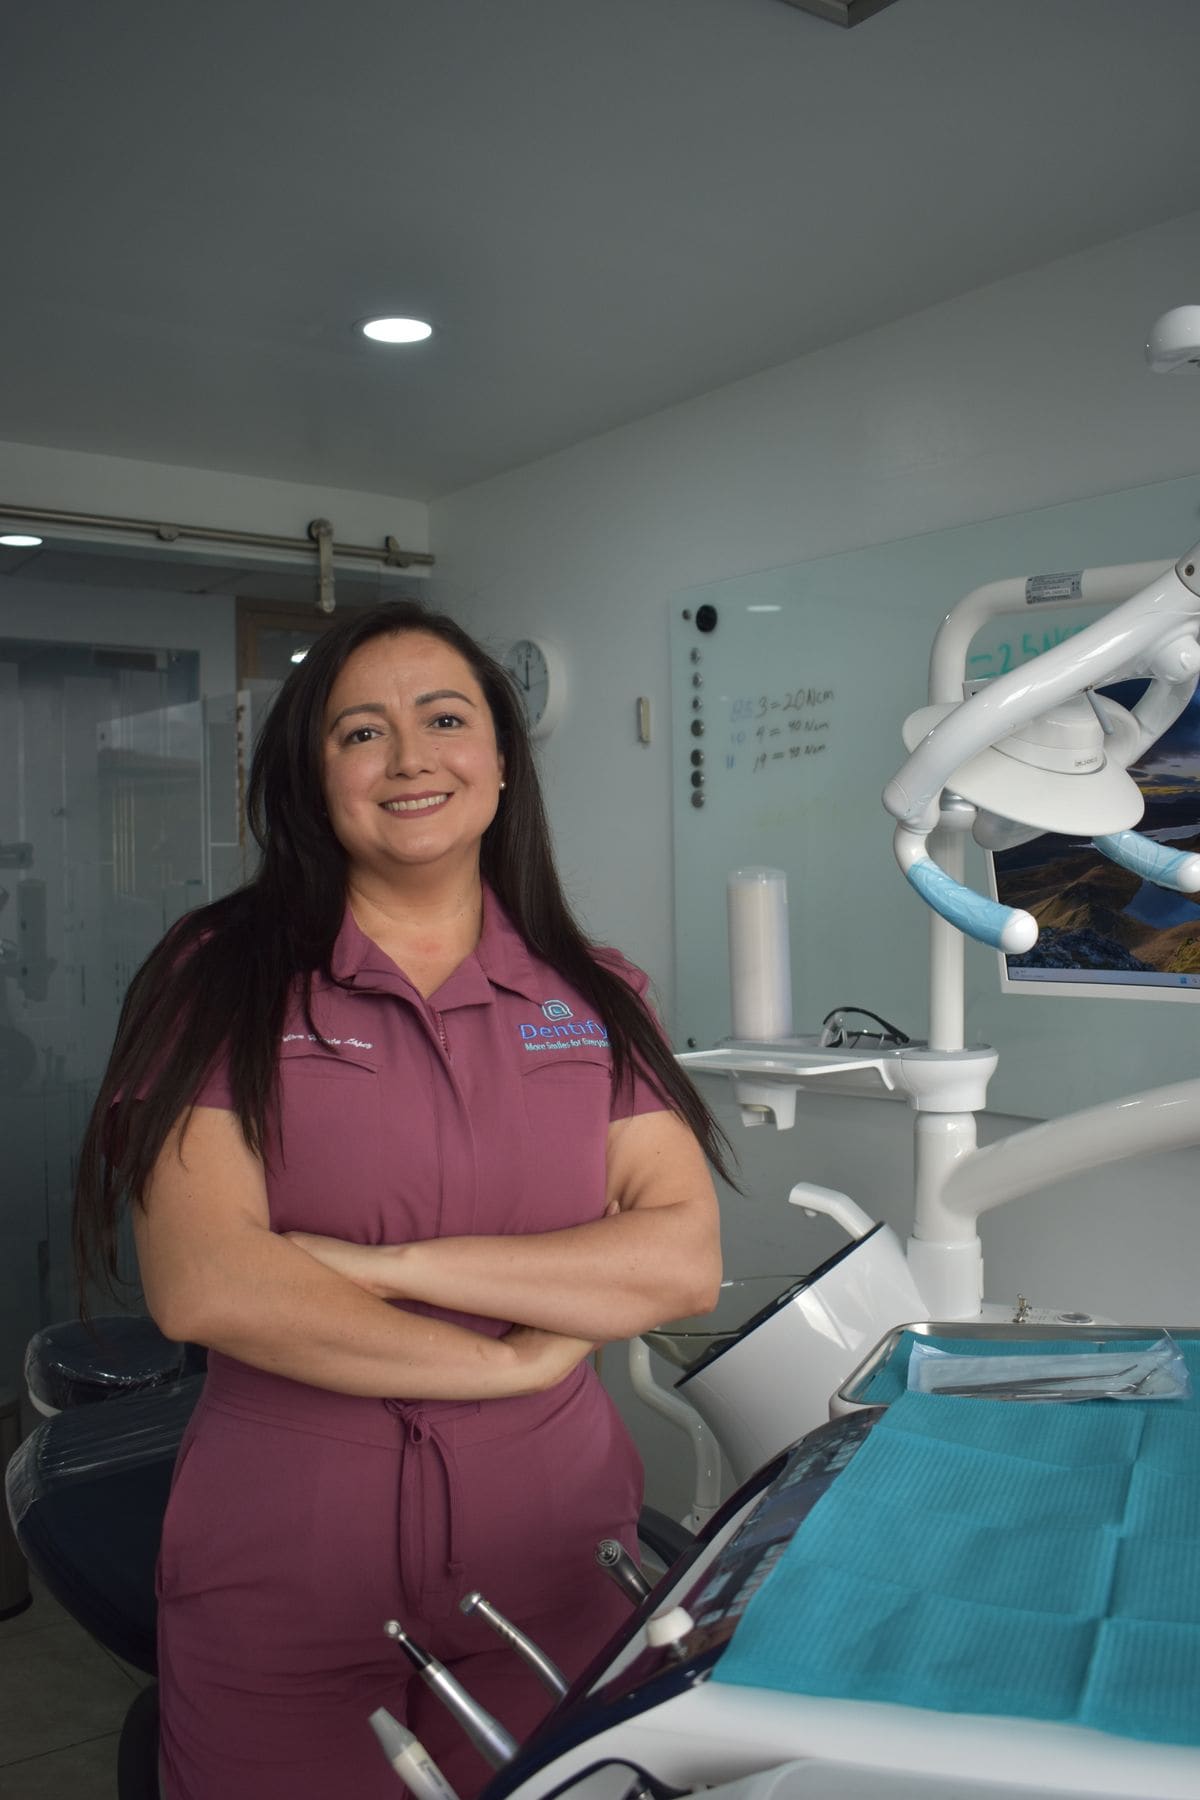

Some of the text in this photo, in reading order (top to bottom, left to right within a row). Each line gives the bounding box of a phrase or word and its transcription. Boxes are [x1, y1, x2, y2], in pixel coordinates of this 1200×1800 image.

[519, 1020, 609, 1039] Dentify
[524, 1042, 545, 1051] More
[581, 1037, 611, 1048] Everyo
